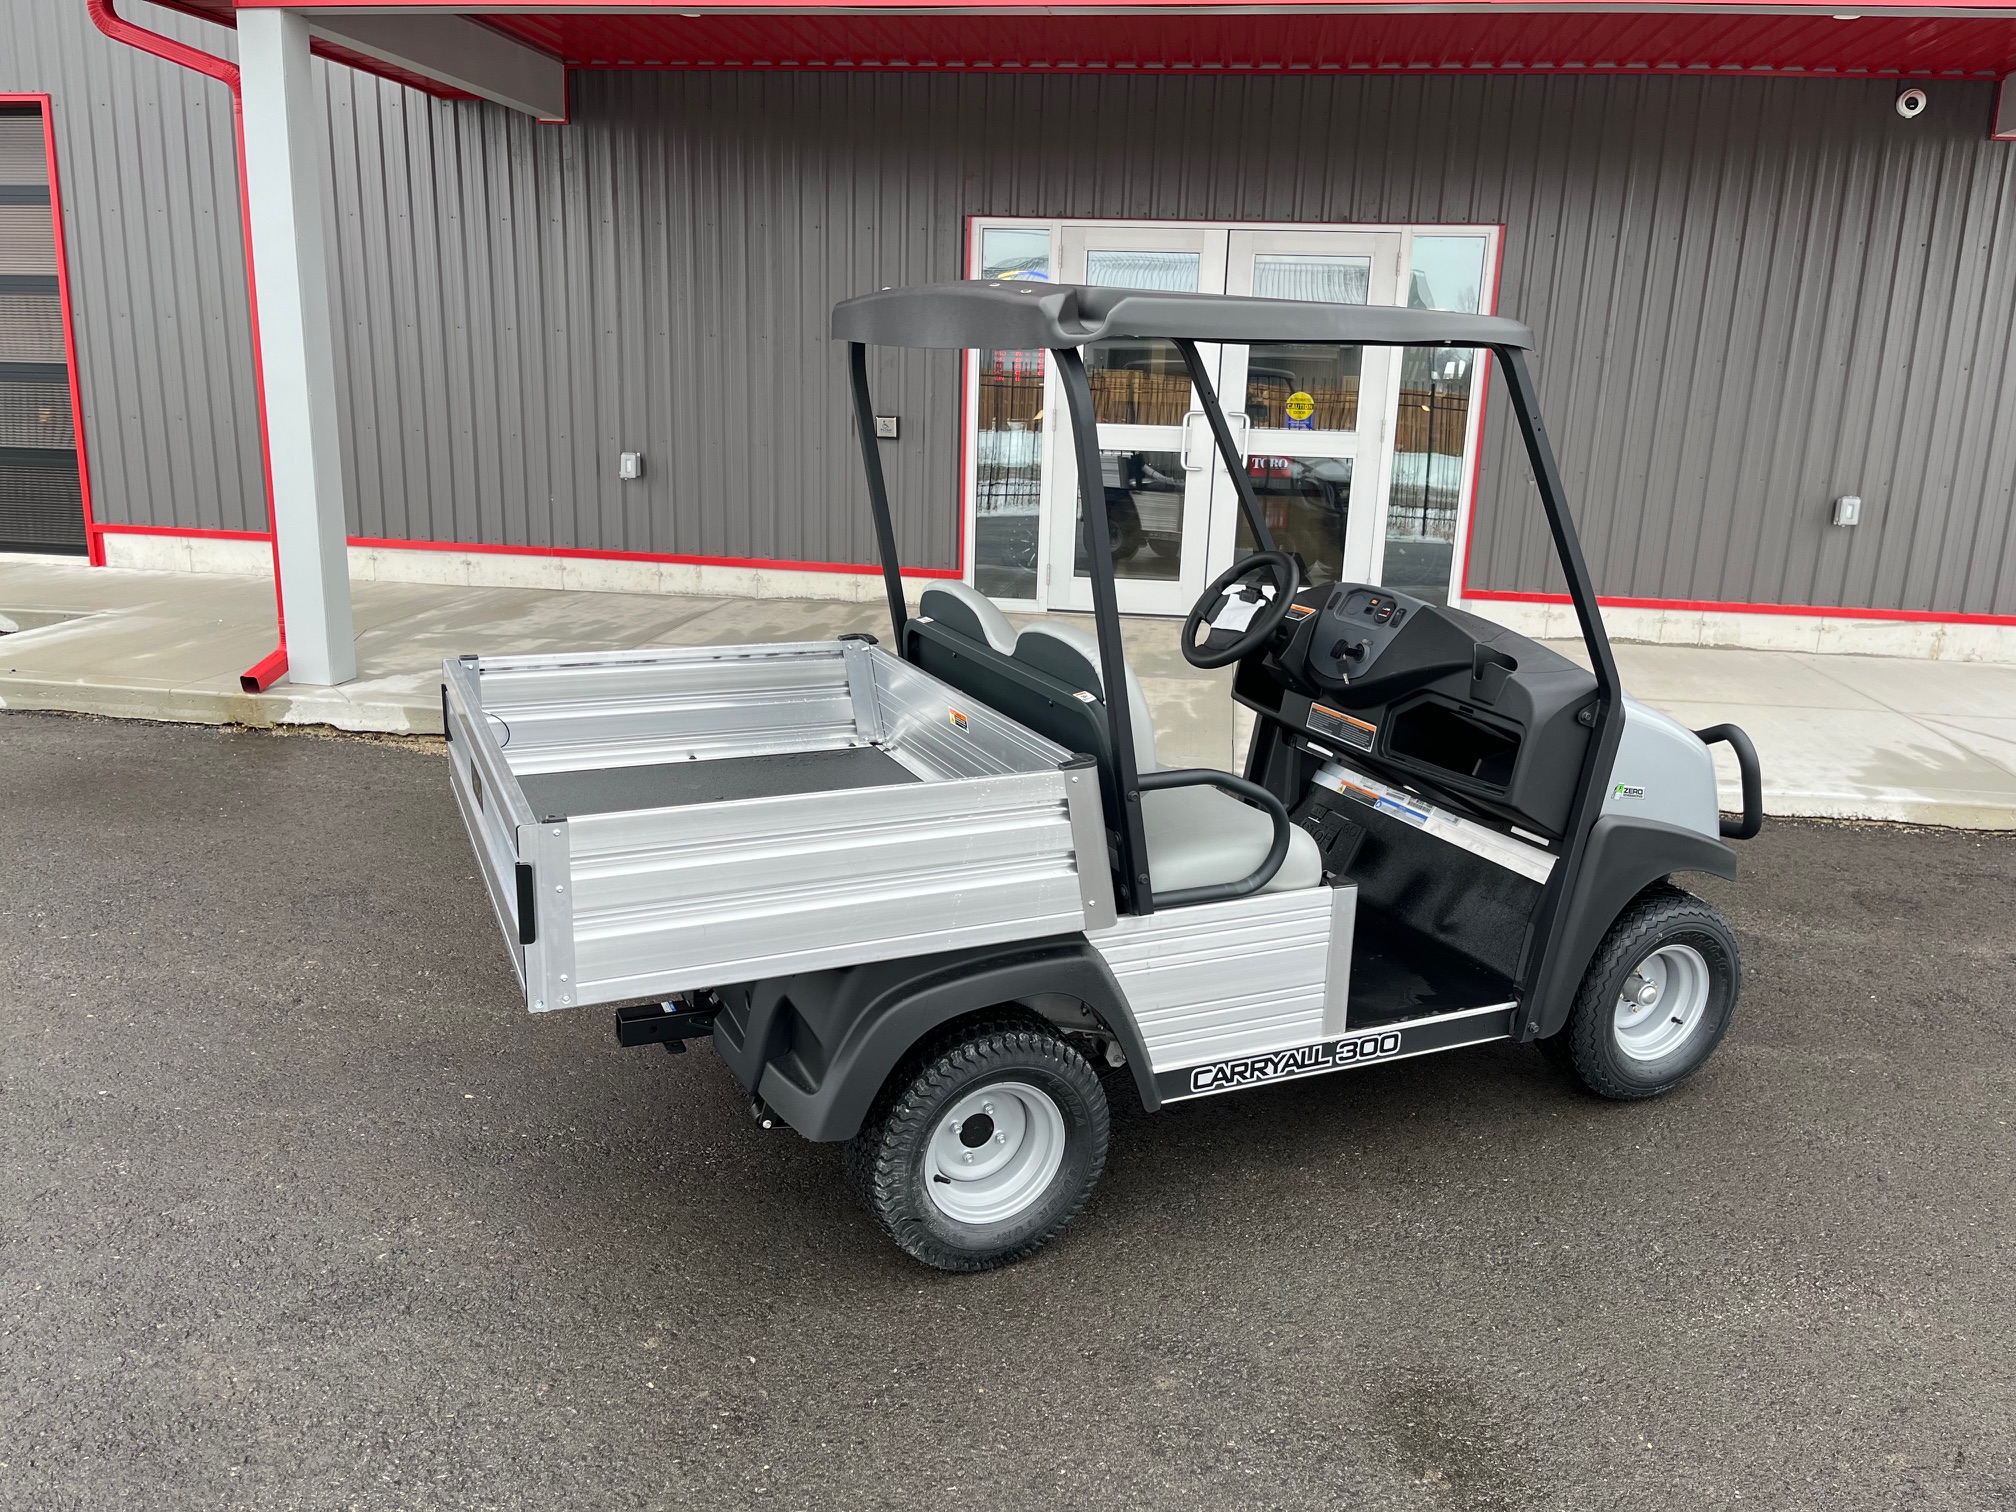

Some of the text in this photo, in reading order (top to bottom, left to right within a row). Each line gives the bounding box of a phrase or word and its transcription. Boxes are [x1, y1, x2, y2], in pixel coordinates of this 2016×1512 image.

[1623, 787, 1644, 795] ZERO
[1190, 1031, 1401, 1092] CARRYALL 300
[1047, 1077, 1087, 1127] KENDA
